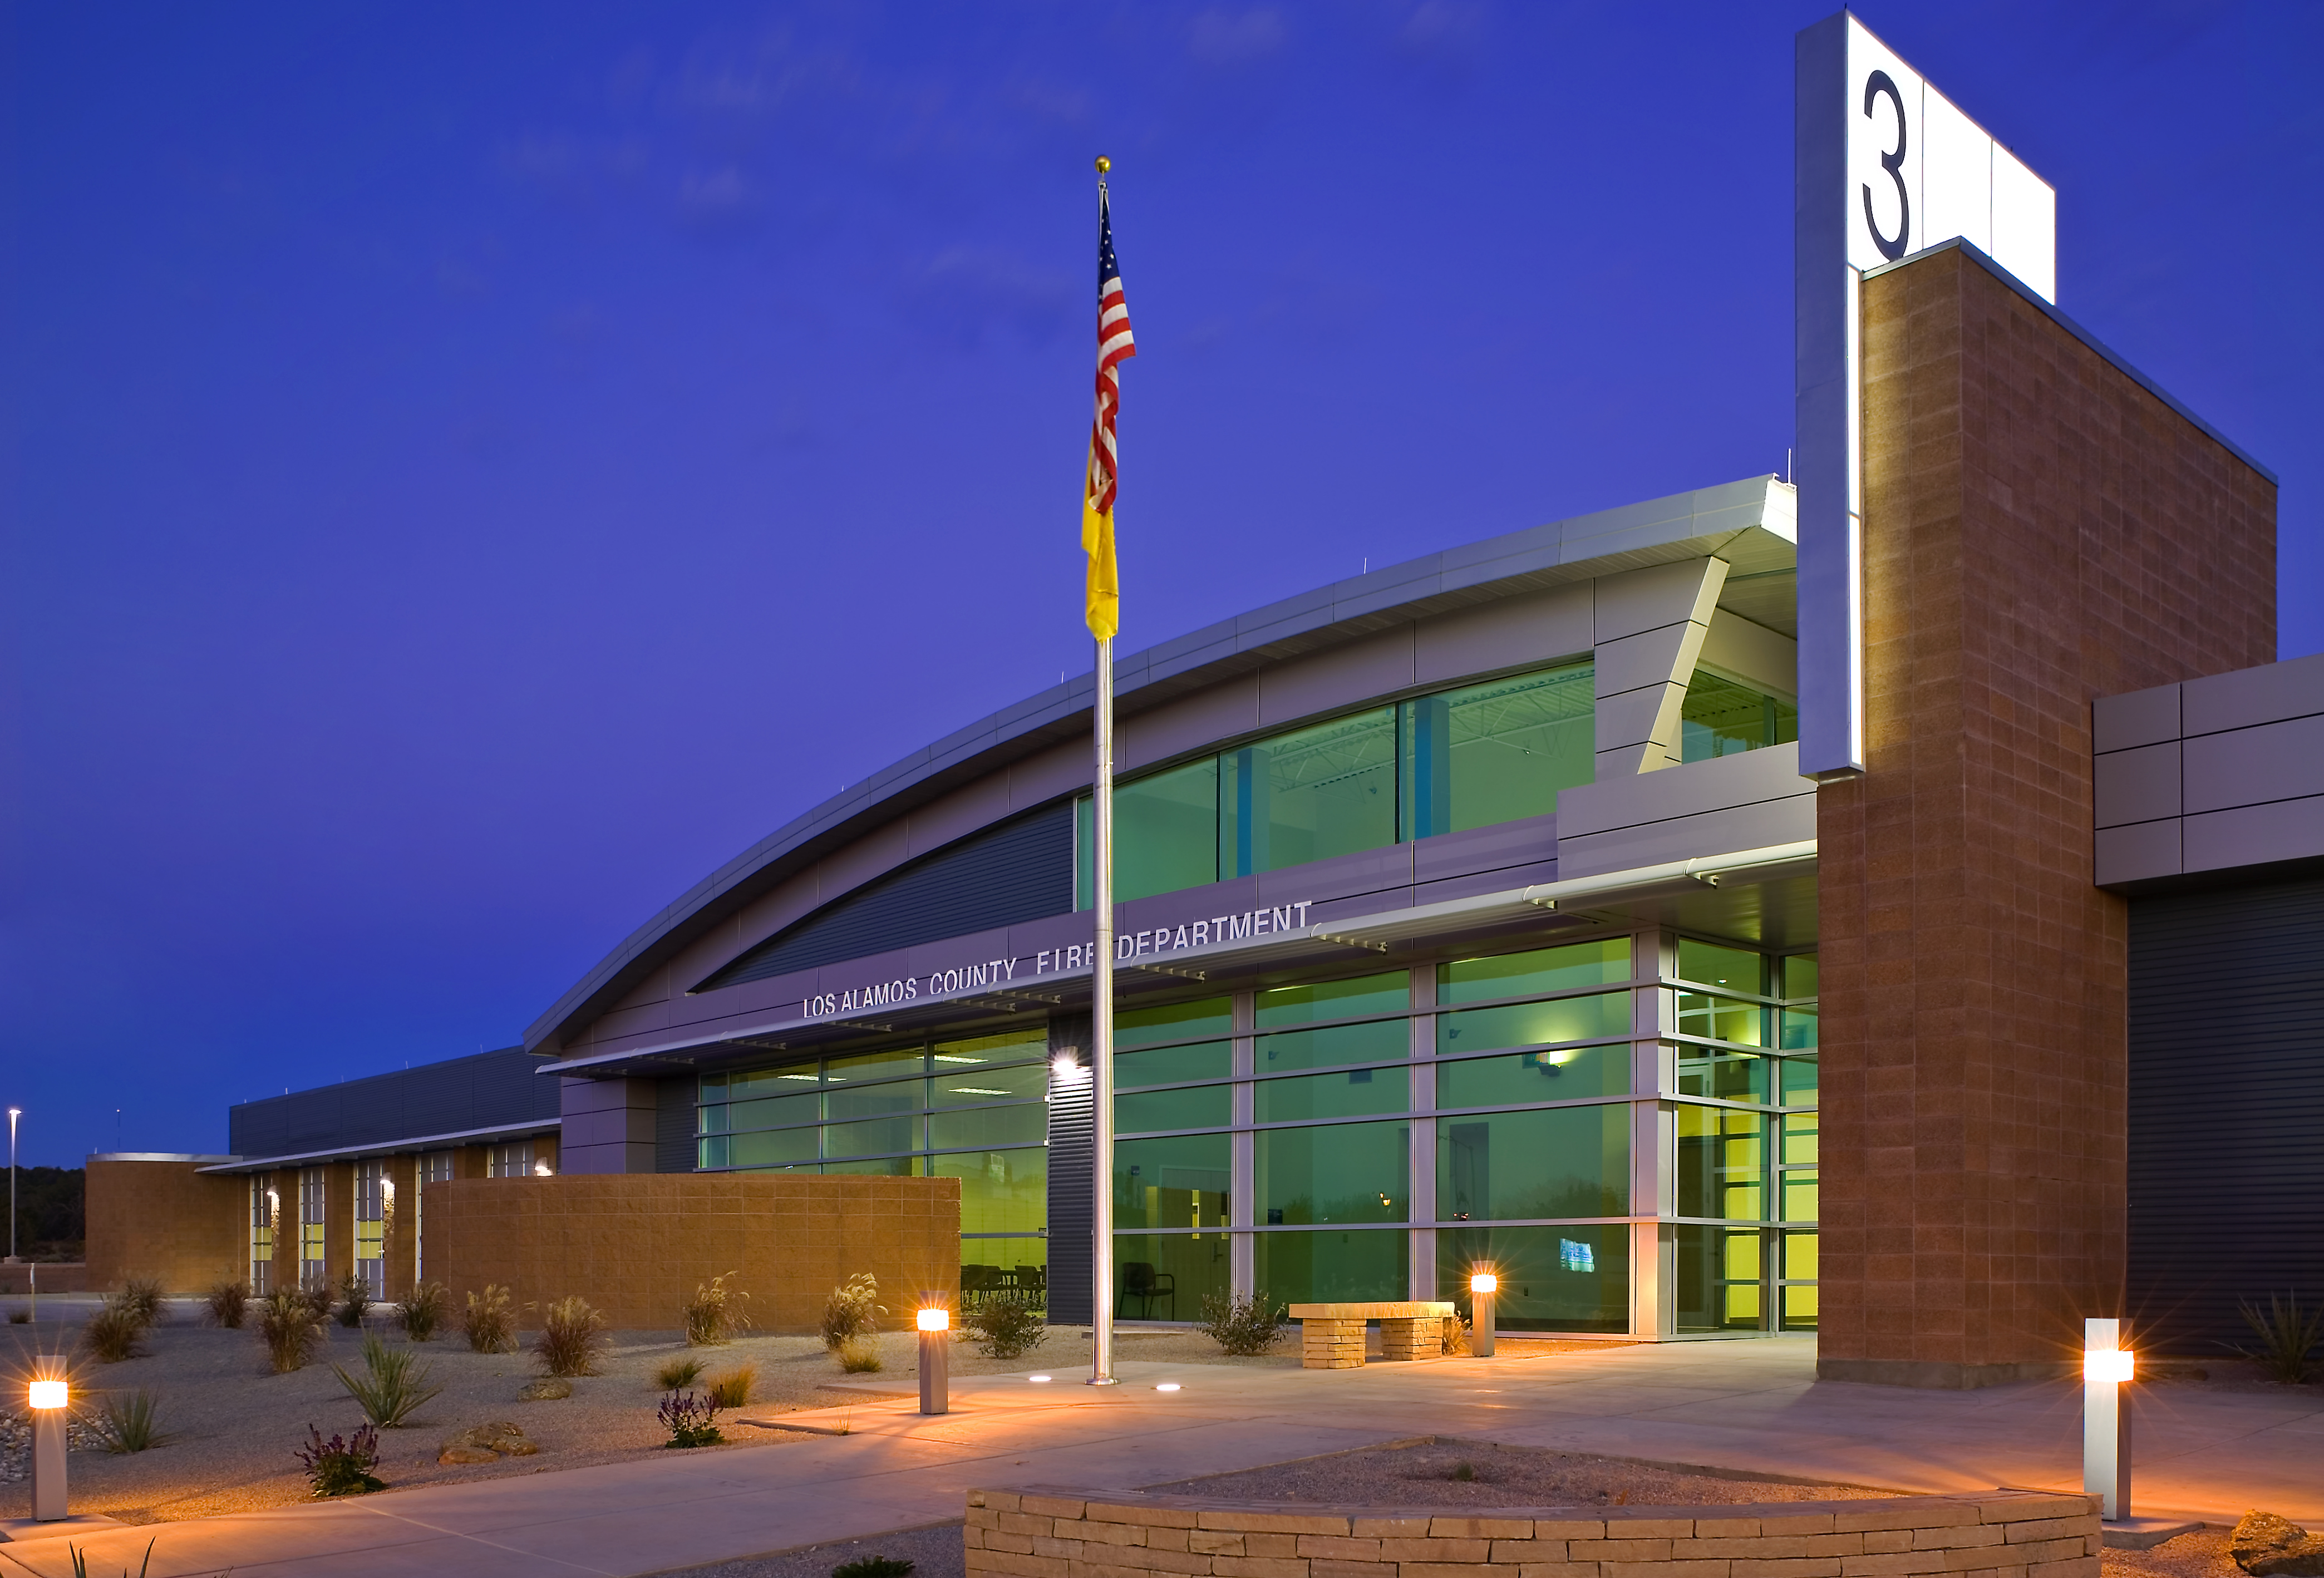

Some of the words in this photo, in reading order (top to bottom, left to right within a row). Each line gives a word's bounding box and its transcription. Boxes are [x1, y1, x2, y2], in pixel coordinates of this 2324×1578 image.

[1863, 70, 1909, 262] 3
[804, 994, 835, 1018] LOS
[841, 978, 917, 1012] ALAMOS
[930, 958, 1016, 994] COUNTY
[1037, 942, 1093, 974] FIRE
[1118, 901, 1312, 960] DEPARTMENT
